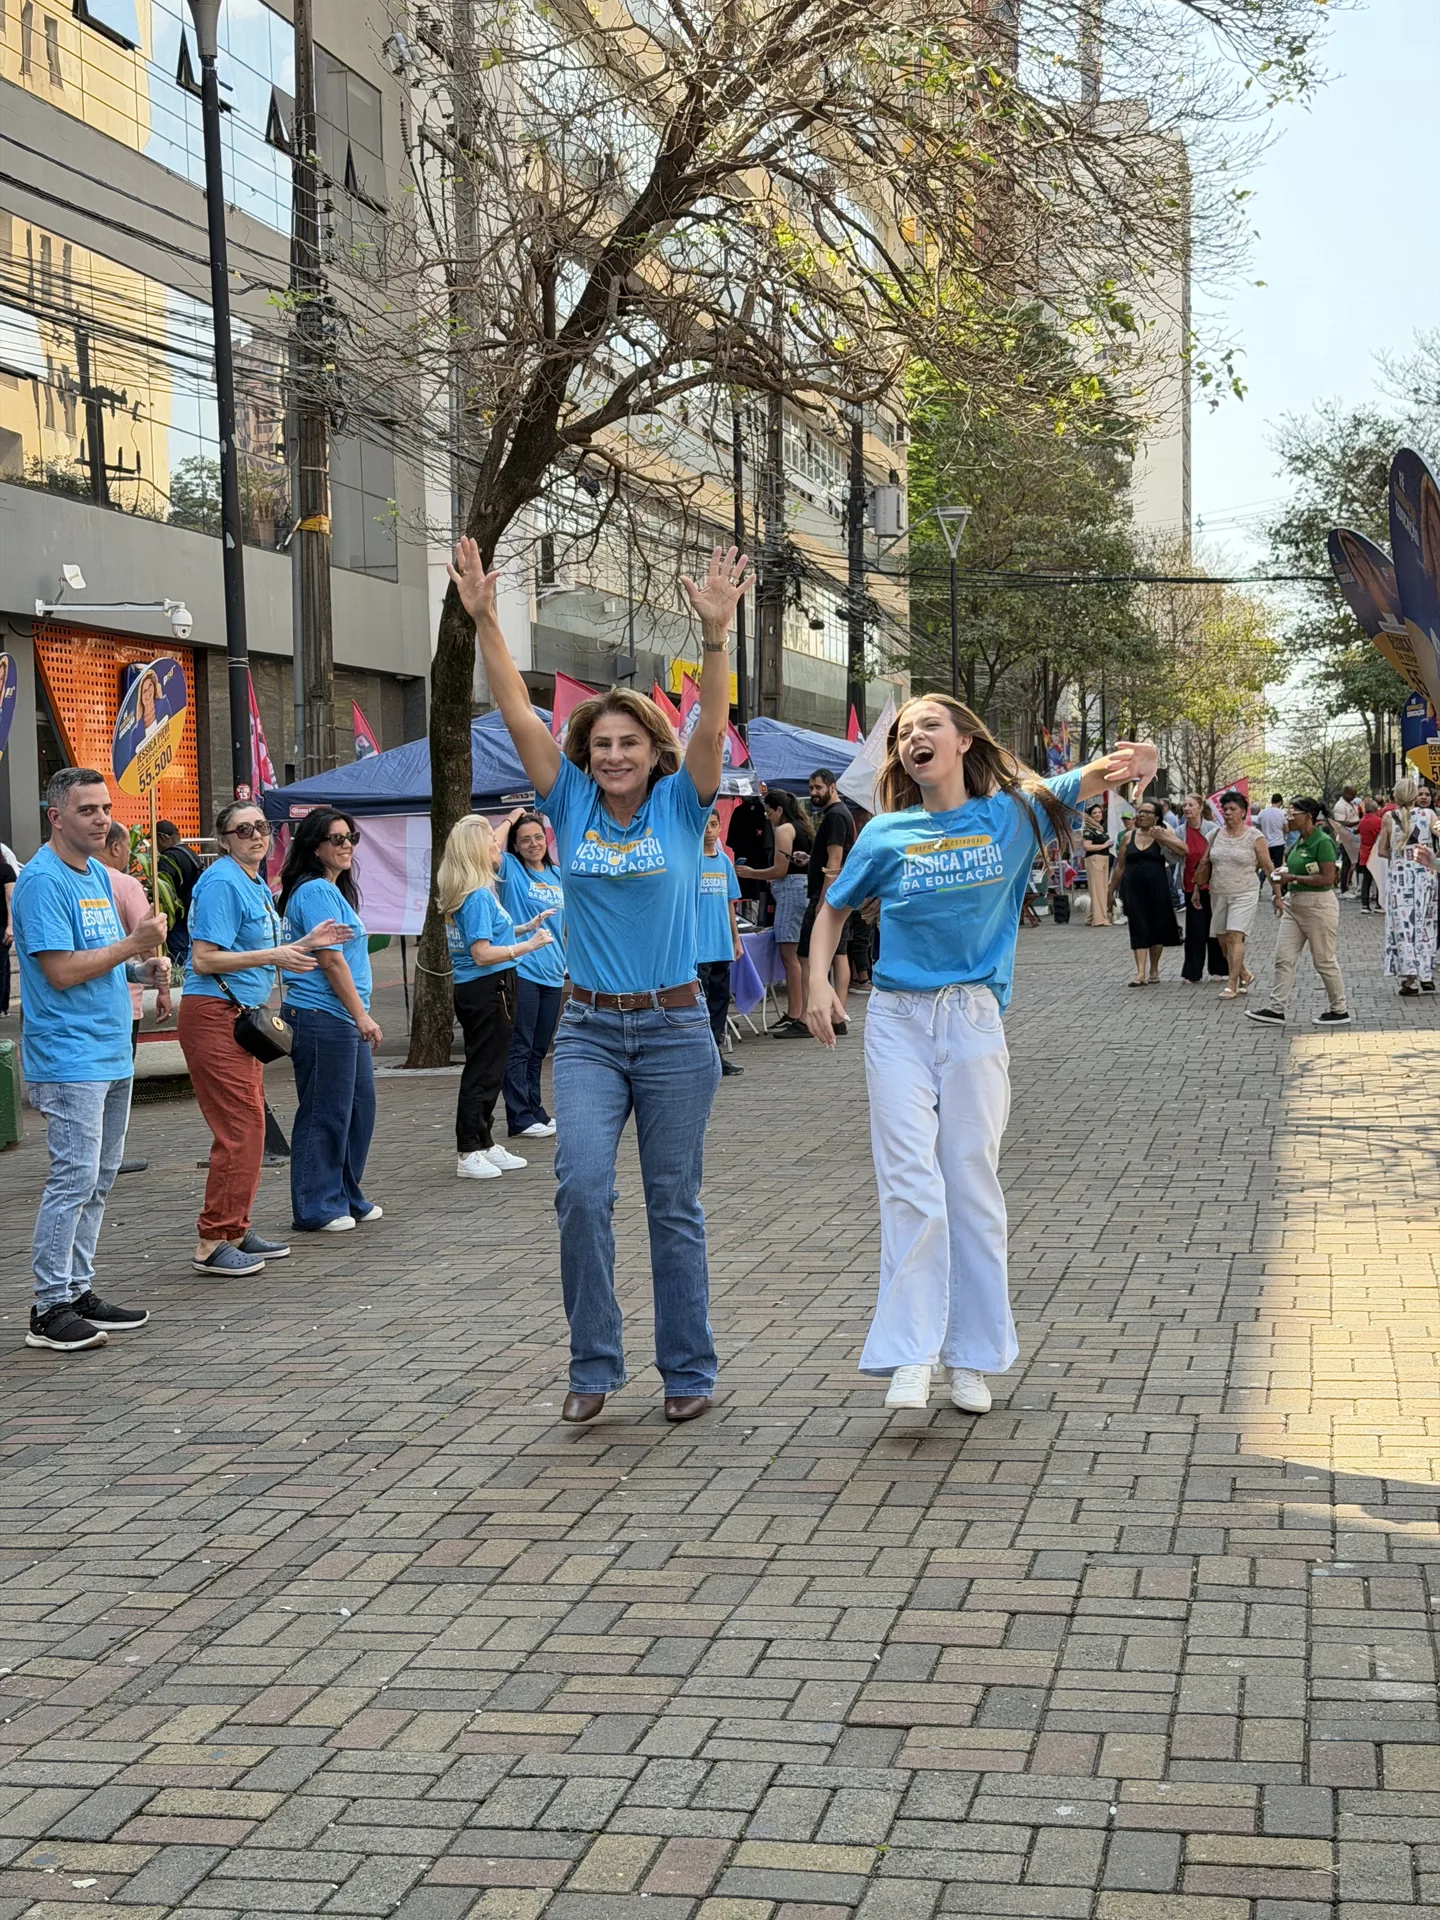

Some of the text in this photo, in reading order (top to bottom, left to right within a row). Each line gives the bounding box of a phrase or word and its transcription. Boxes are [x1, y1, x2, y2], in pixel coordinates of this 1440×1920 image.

[138, 744, 172, 793] 55.500
[635, 837, 663, 857] IERI
[963, 843, 1003, 869] PIERI
[571, 856, 665, 876] DA EDUCAÇÃO
[903, 865, 1004, 891] DA EDUCAÇÃO
[84, 928, 97, 938] DA
